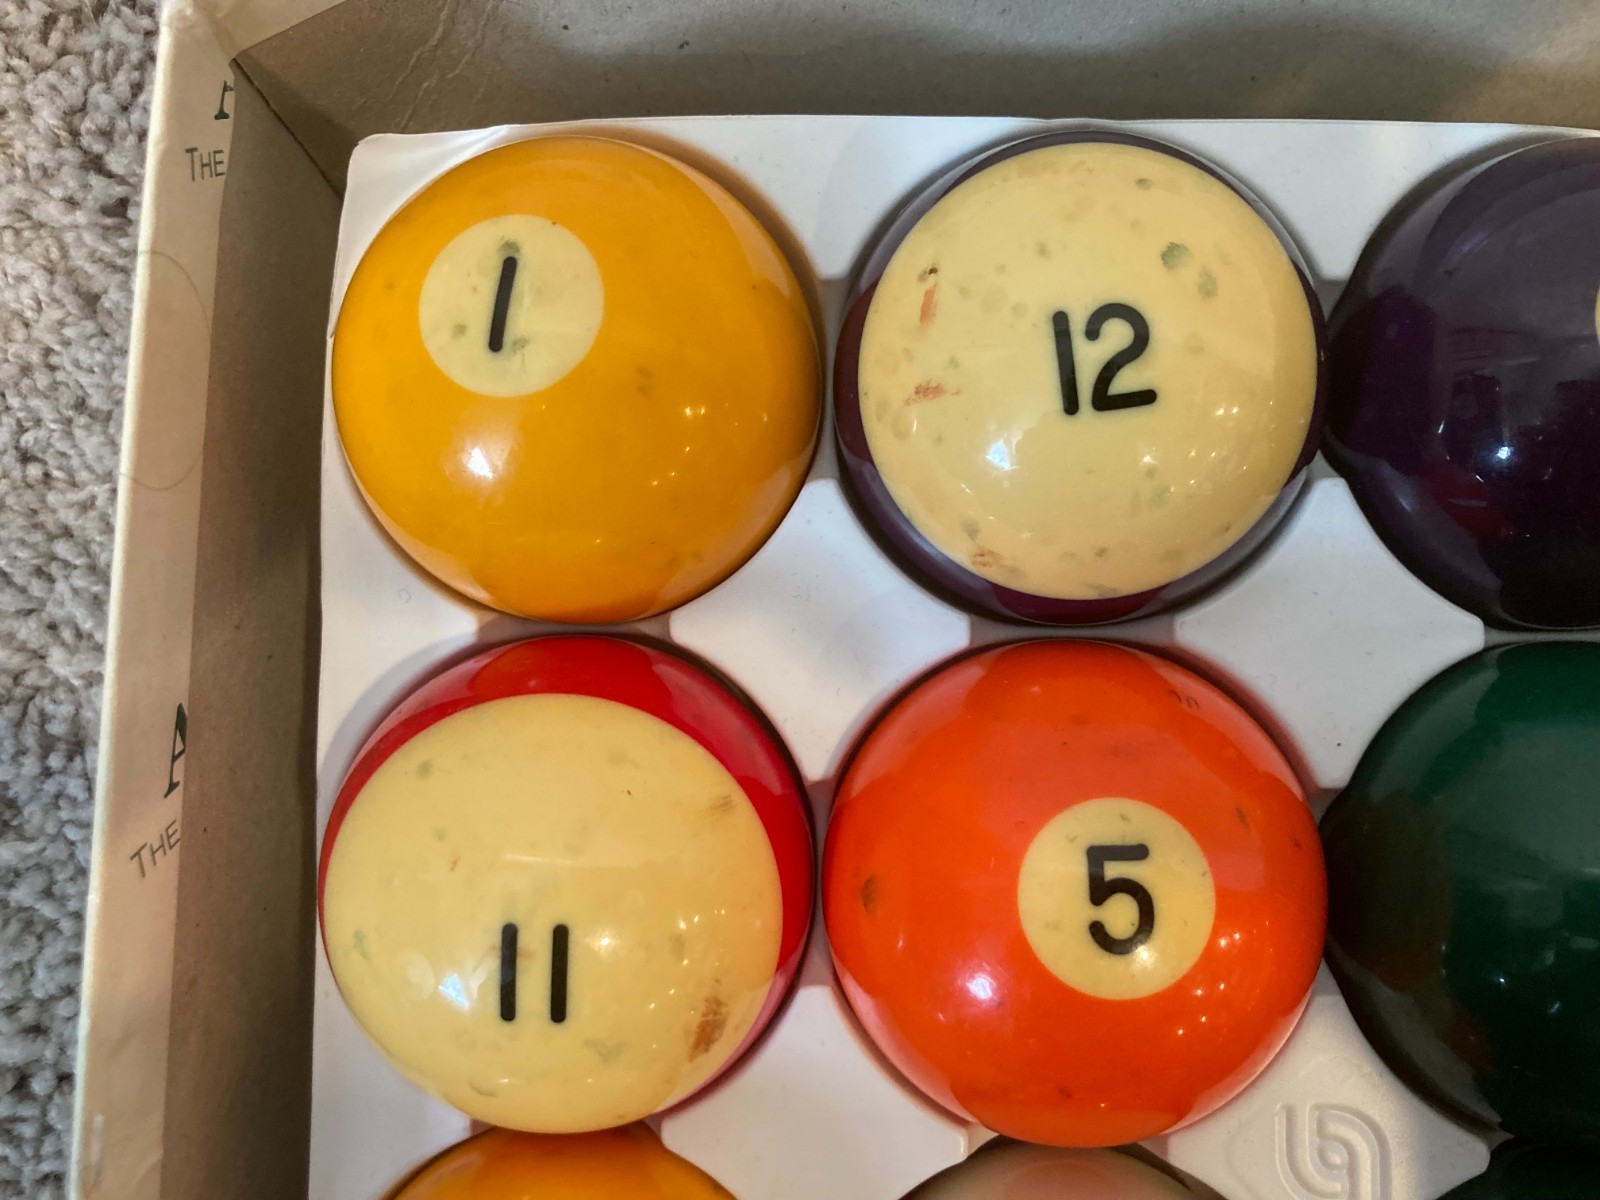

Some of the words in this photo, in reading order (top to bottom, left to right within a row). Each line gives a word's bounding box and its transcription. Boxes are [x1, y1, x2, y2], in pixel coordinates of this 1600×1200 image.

[185, 147, 226, 182] THE
[488, 256, 518, 352] 1
[1052, 302, 1157, 416] 12
[130, 819, 181, 879] THE
[1086, 843, 1155, 955] 5
[500, 922, 569, 1023] 11
